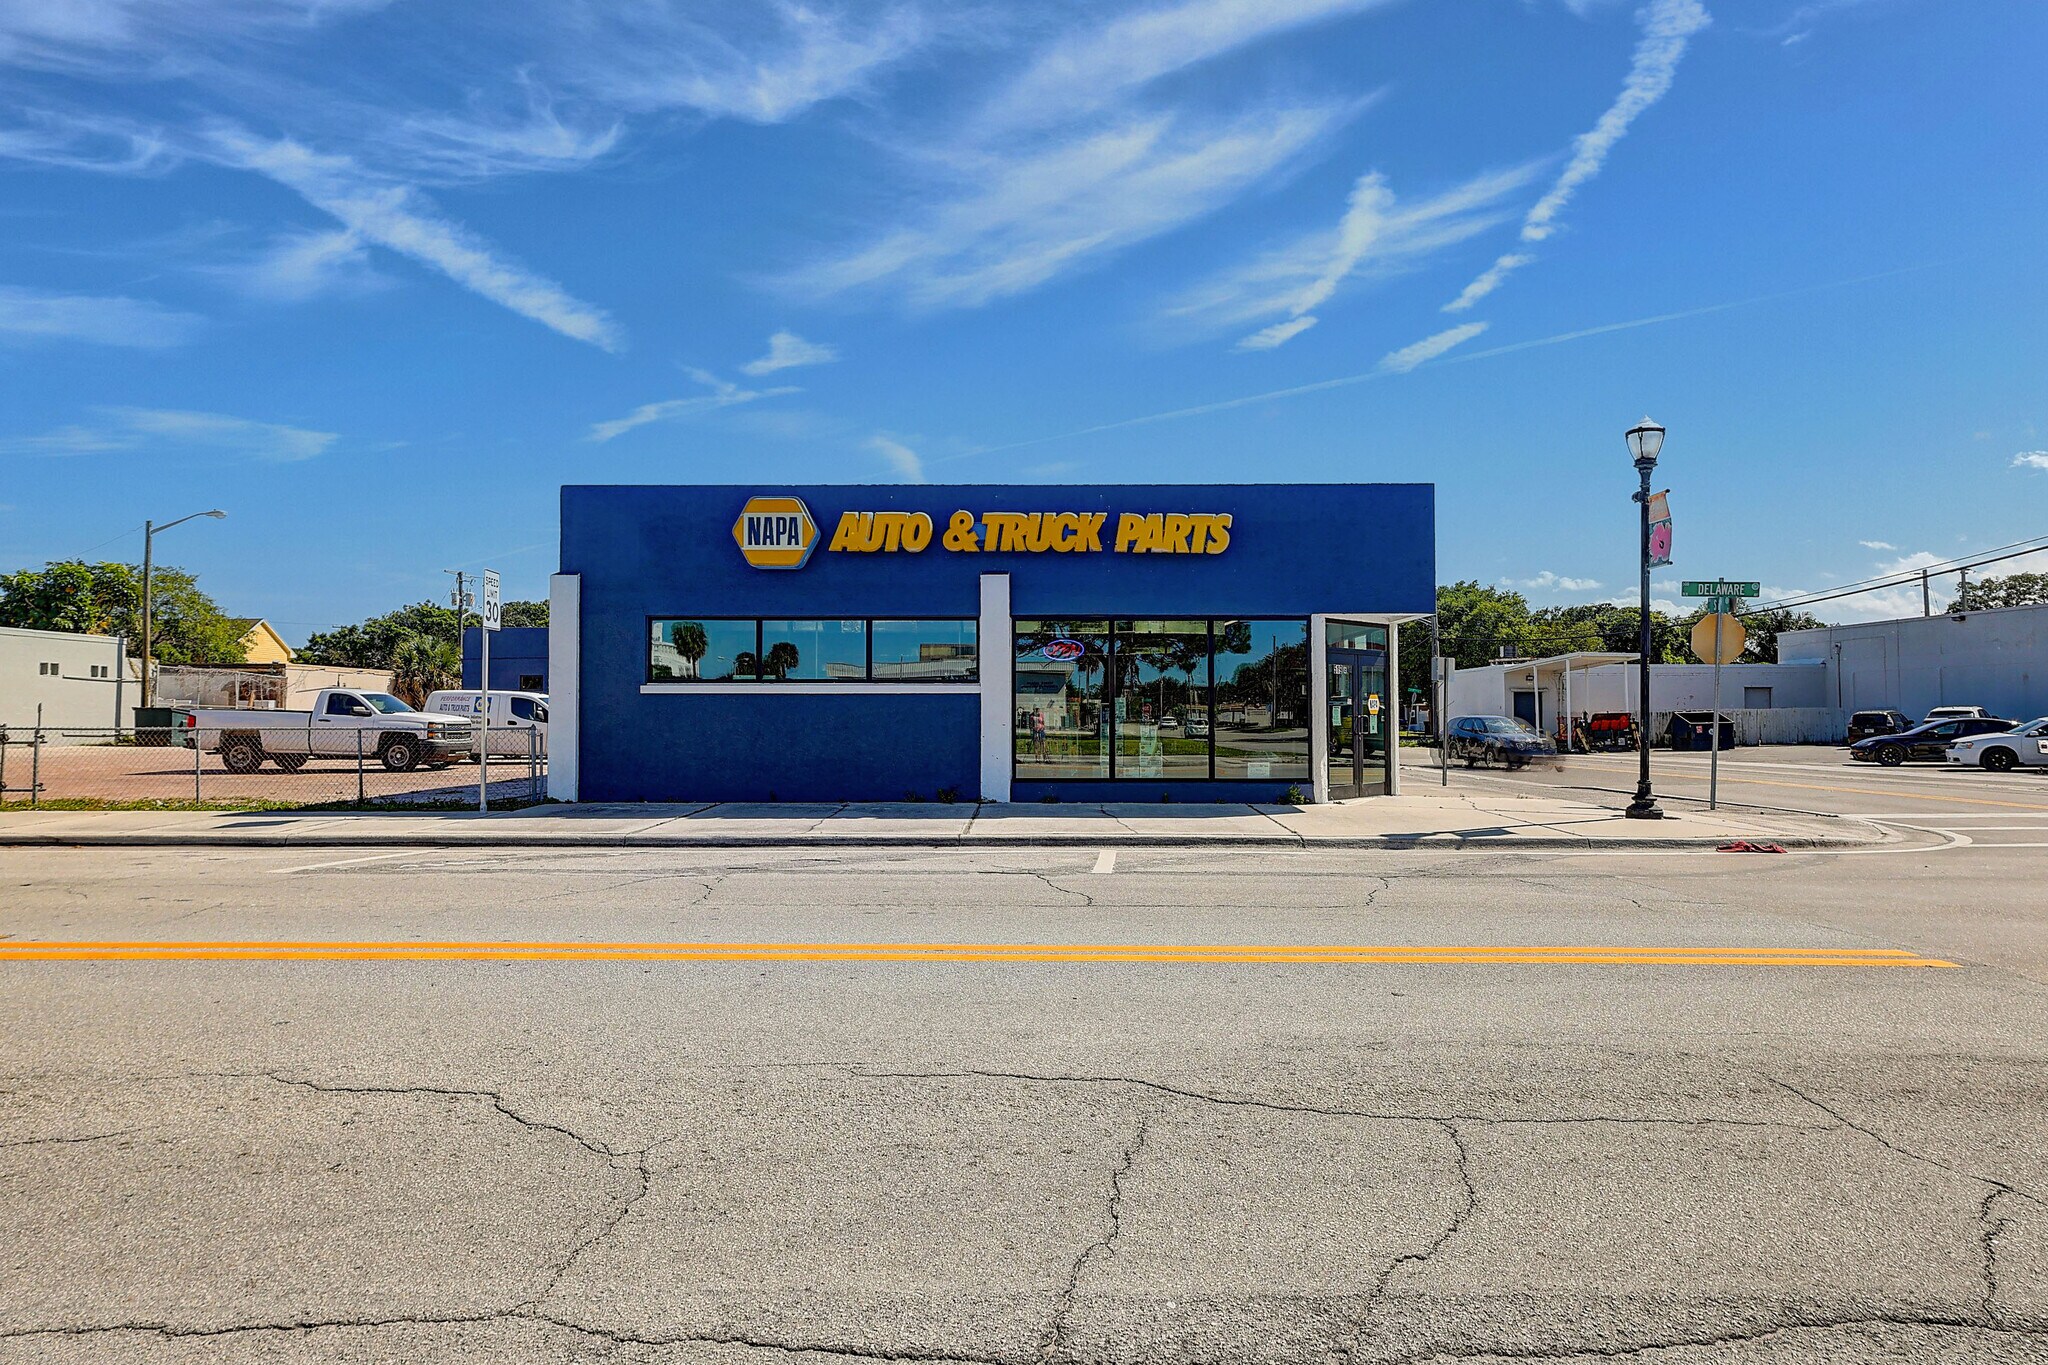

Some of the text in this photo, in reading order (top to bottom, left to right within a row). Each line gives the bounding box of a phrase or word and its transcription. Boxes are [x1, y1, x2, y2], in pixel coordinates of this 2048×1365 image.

[747, 516, 800, 546] NAPA
[828, 509, 1233, 554] AUTO & TRUCK PARTS
[485, 576, 499, 588] SPEED
[1698, 583, 1745, 595] DELAWARE
[486, 588, 498, 599] LIMIT
[485, 600, 499, 623] 30
